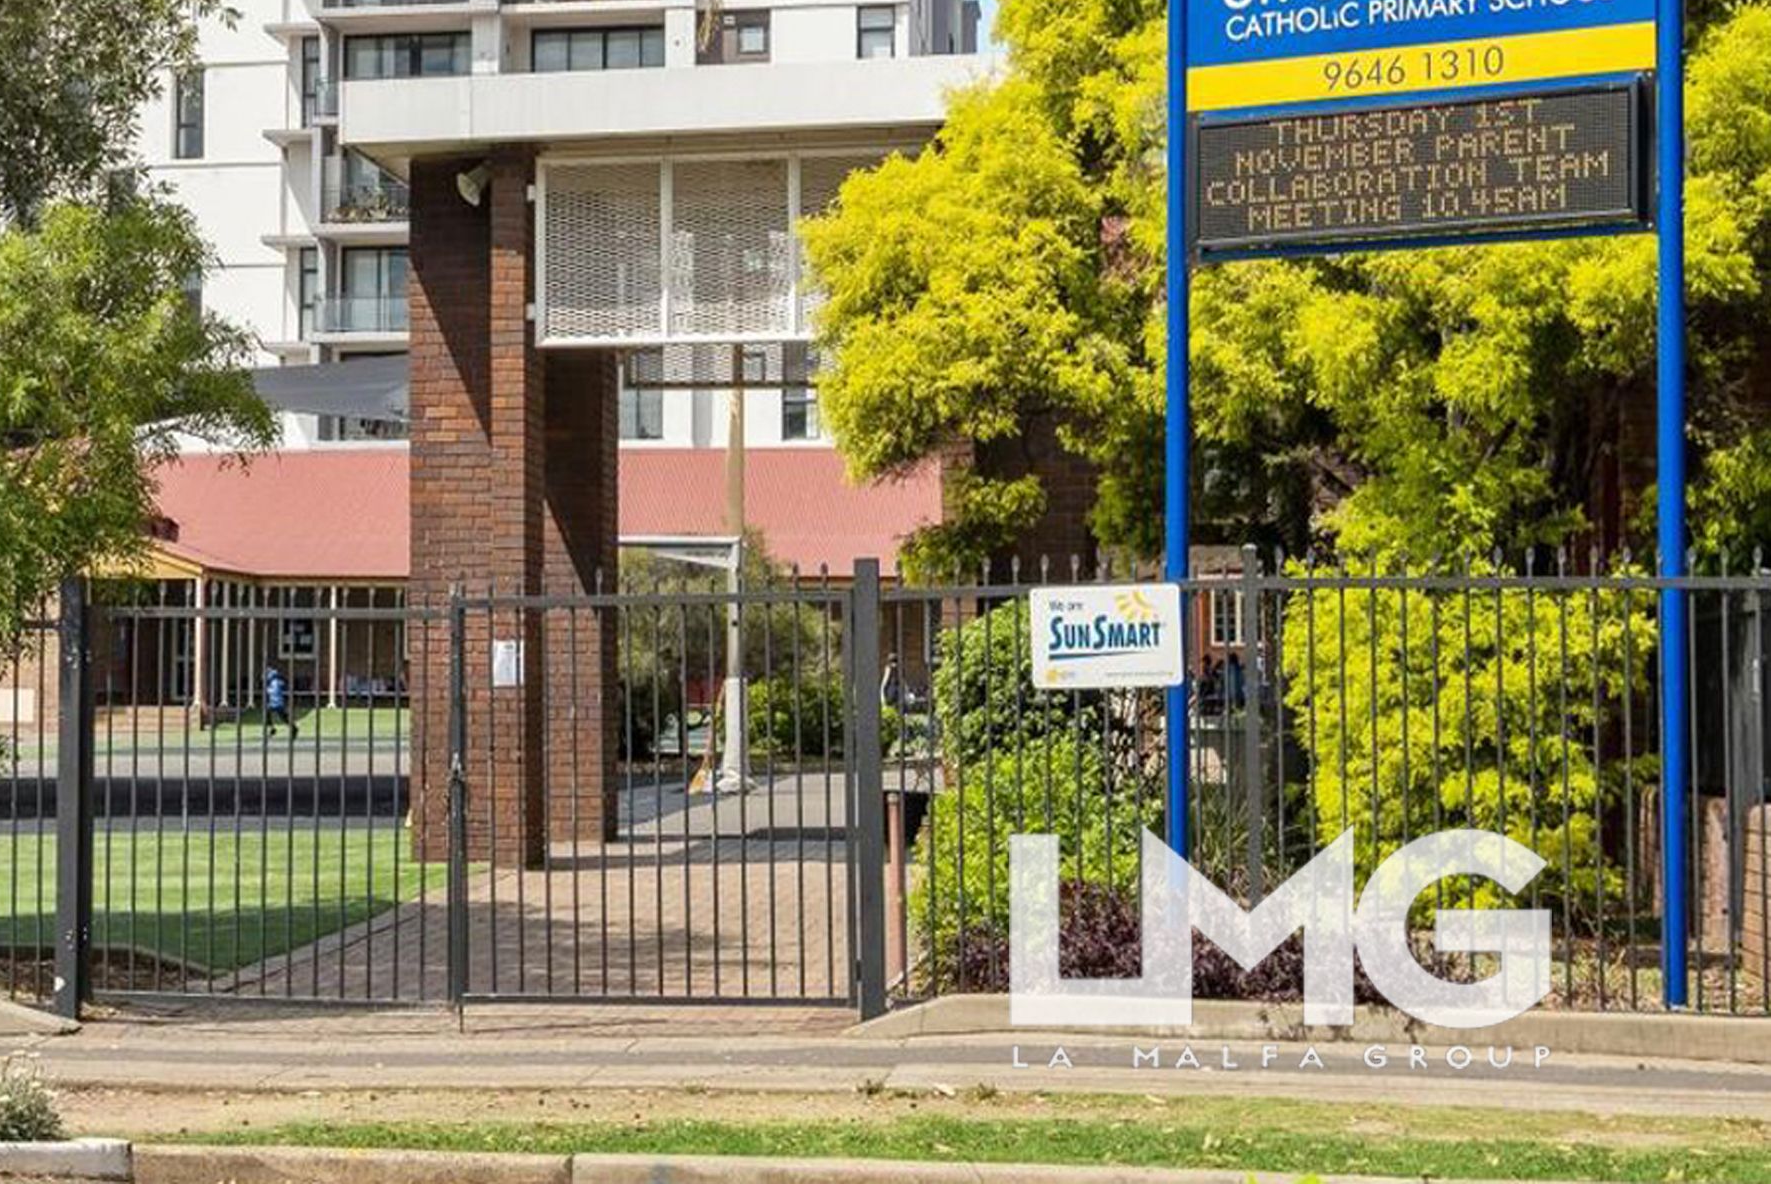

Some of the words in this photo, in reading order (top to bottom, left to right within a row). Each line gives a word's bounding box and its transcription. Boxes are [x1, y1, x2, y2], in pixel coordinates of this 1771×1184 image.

[1225, 1, 1361, 42] CATHOLIC
[1323, 54, 1406, 91] 9646
[1423, 45, 1504, 81] 1310
[1269, 106, 1455, 145] THURSDAY
[1476, 98, 1544, 129] 1ST
[1235, 138, 1416, 177] NOVEMBER
[1435, 123, 1575, 160] PARENT
[1207, 160, 1487, 207] COLLABORATION
[1508, 150, 1609, 182] TEAM
[1248, 194, 1402, 232] MEETING
[1422, 183, 1566, 218] 10.45AM
